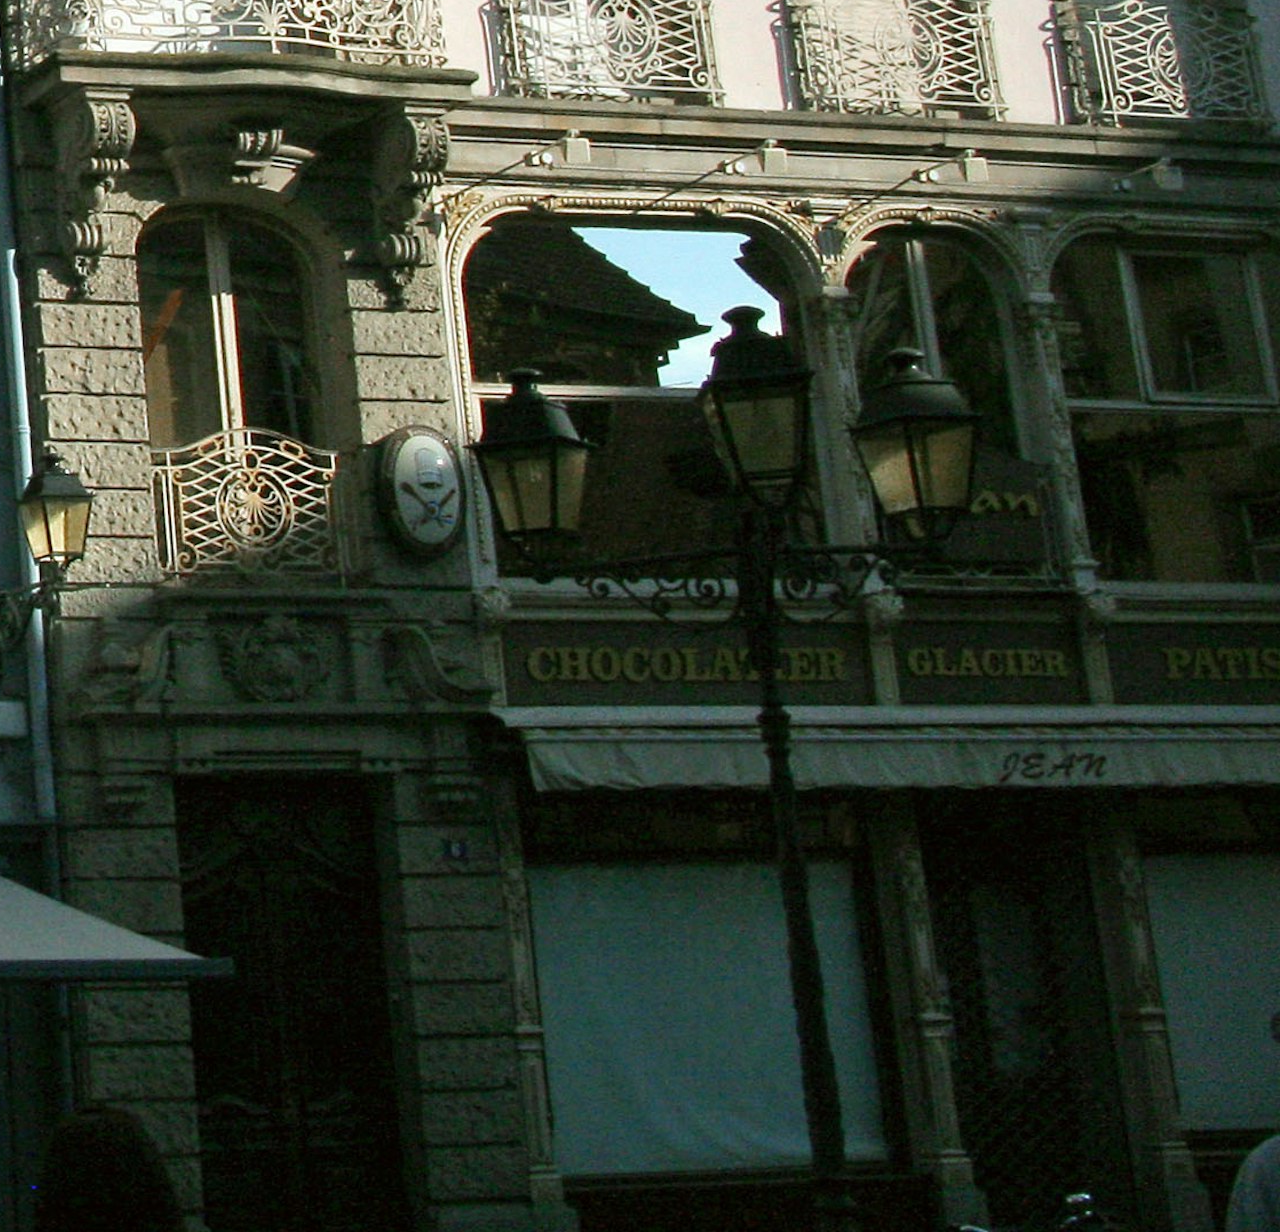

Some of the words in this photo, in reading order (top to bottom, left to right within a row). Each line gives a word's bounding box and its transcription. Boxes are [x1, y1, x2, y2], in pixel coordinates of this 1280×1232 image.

[527, 646, 847, 683] CHOCOLAER
[907, 647, 1069, 678] GLACIER
[1000, 752, 1107, 783] JEAN
